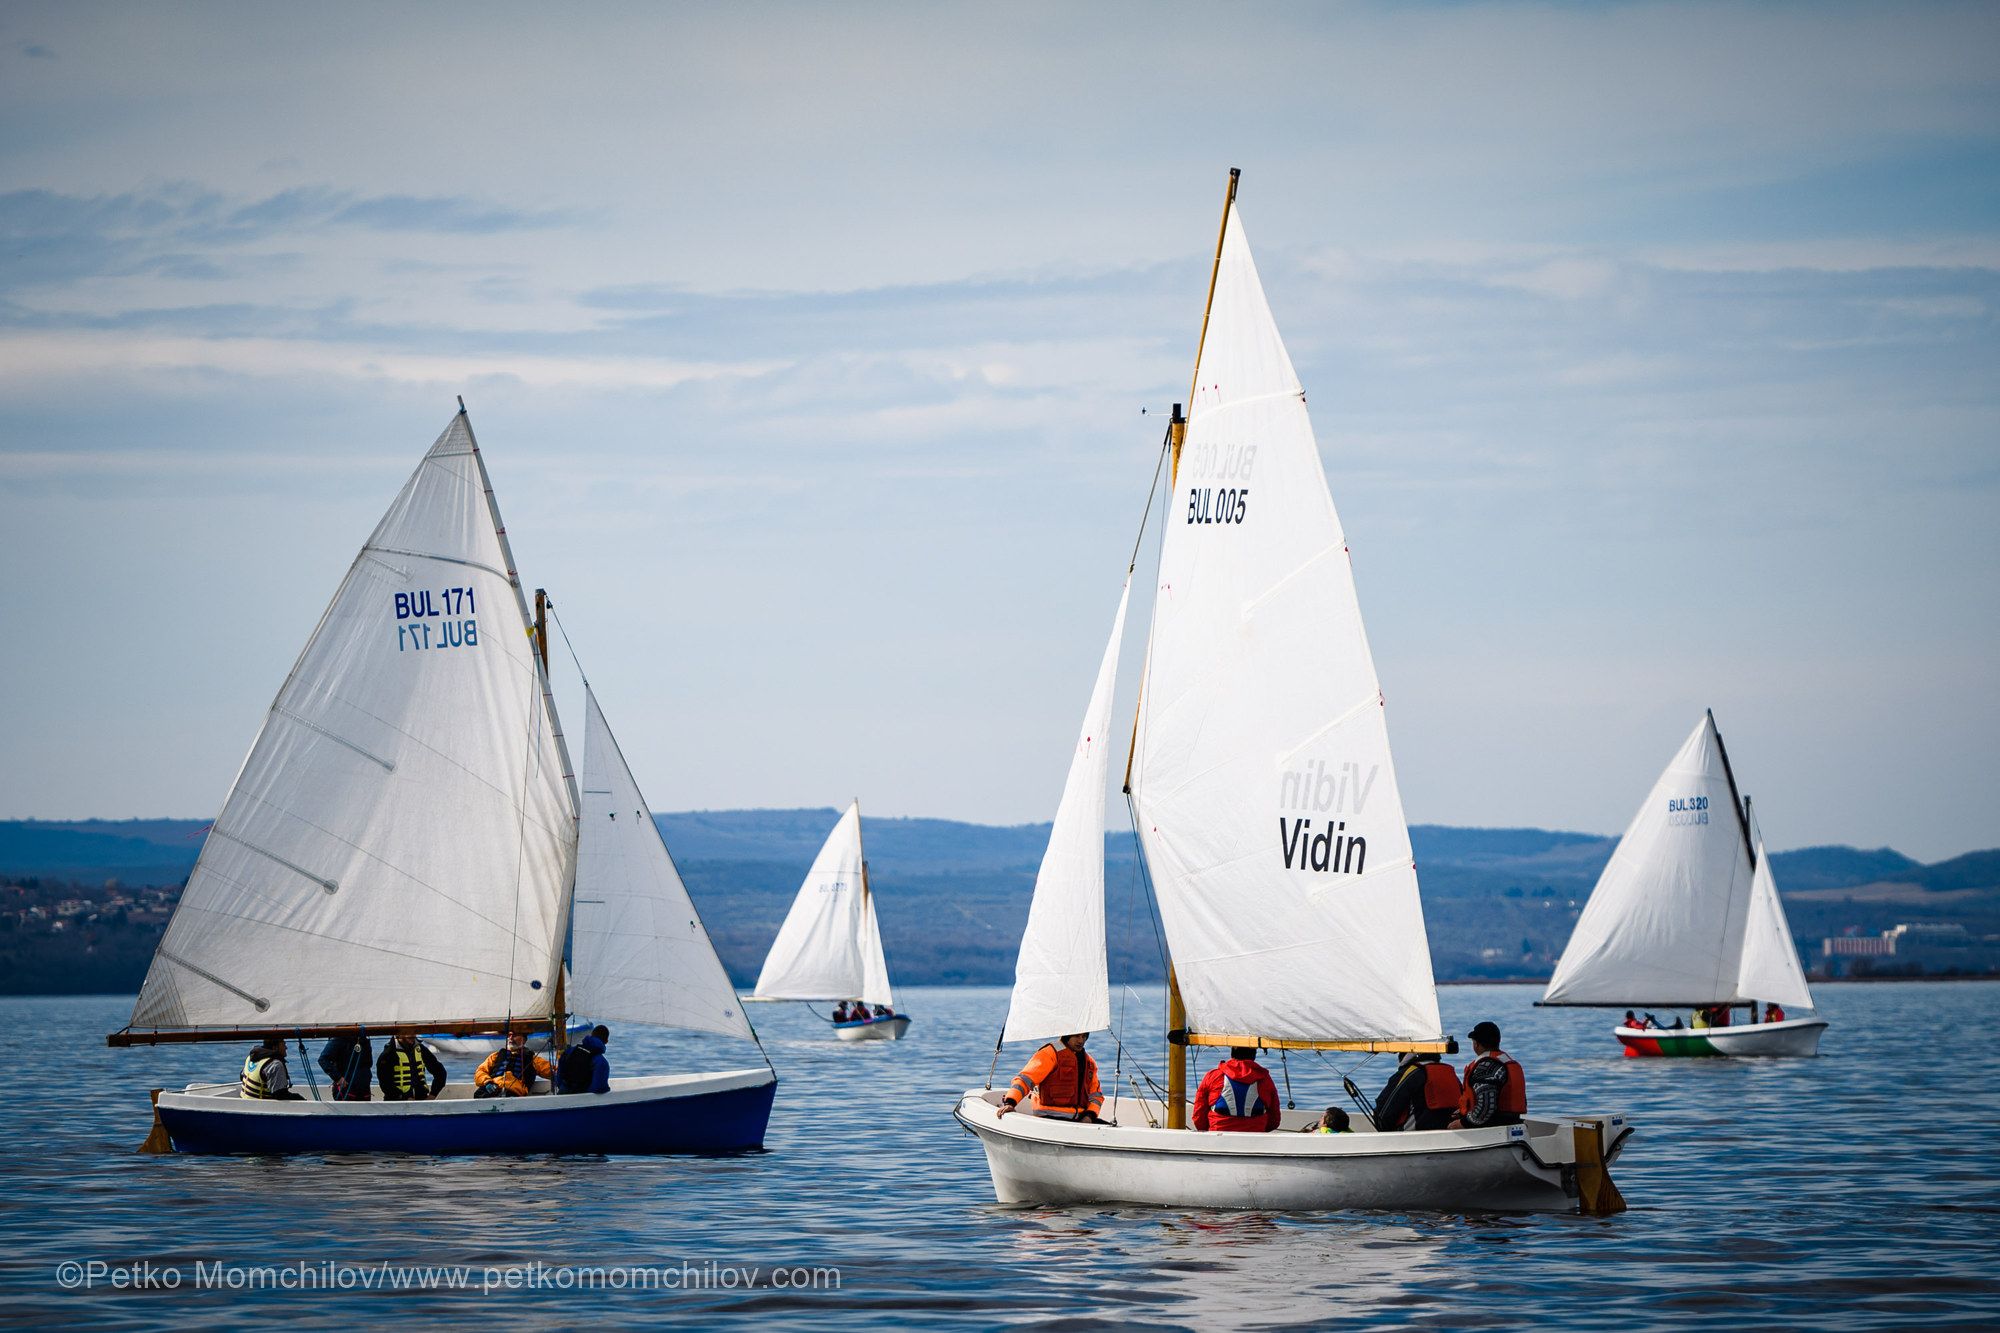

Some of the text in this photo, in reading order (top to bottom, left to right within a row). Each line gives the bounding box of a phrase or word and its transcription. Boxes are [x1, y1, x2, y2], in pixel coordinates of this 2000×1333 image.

[1187, 488, 1249, 525] BUL 005
[394, 587, 475, 619] BUL 171
[1669, 796, 1709, 813] BUL 320
[1280, 817, 1367, 875] Vidin
